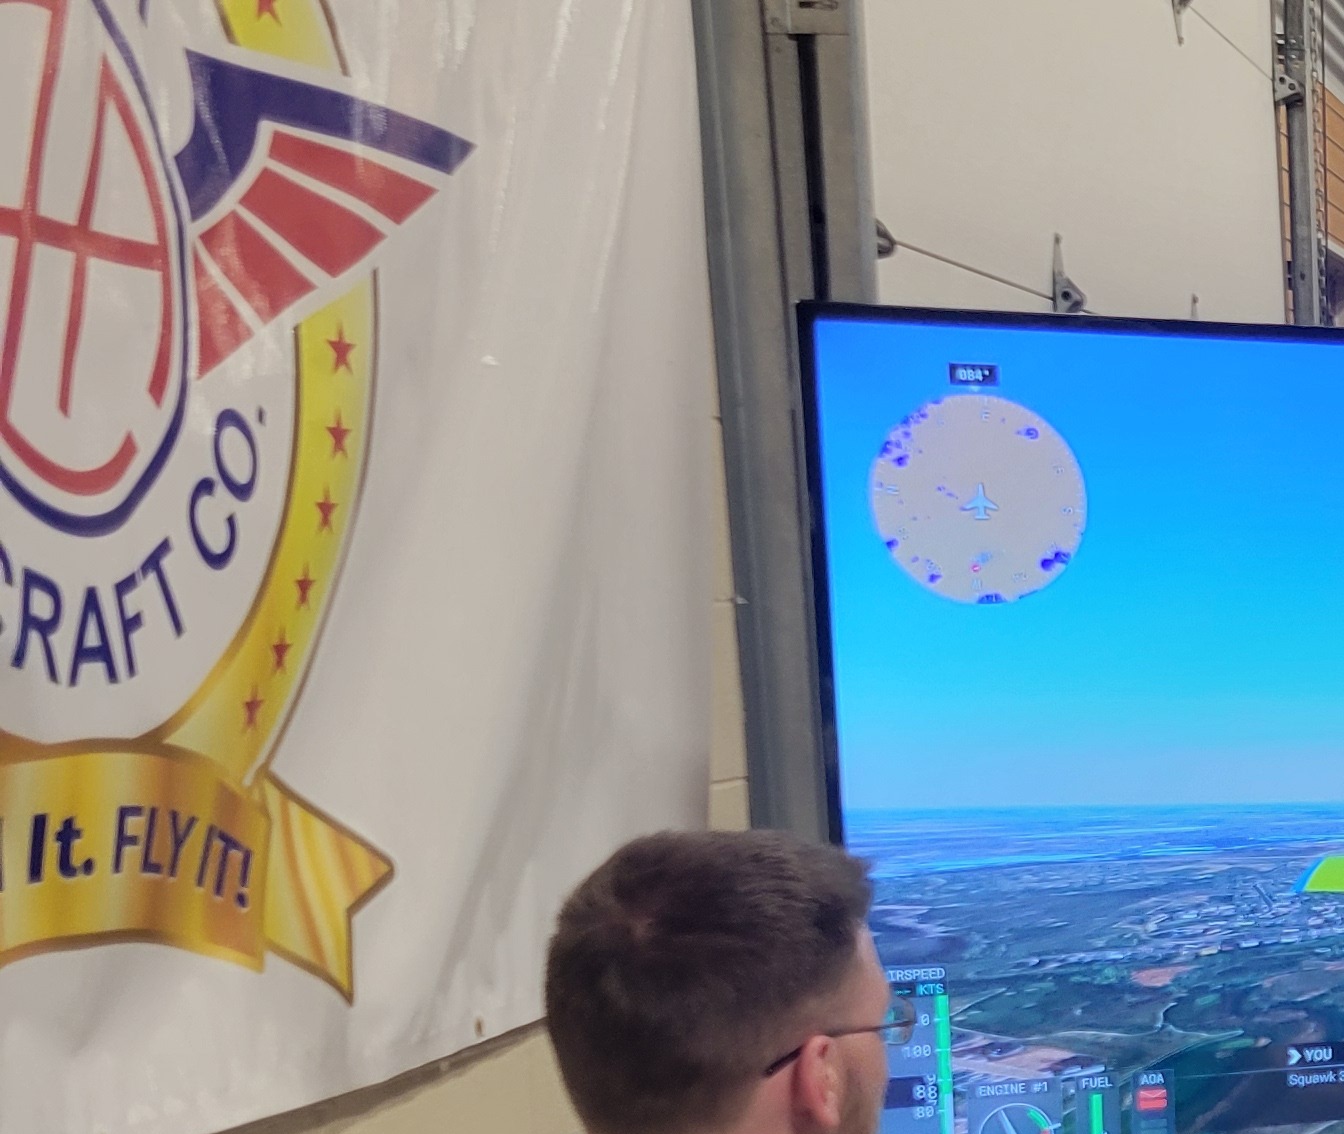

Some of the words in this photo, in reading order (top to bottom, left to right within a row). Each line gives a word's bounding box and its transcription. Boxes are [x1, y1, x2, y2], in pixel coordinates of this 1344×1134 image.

[187, 405, 267, 571] CO.
[28, 813, 96, 884] It.
[112, 804, 199, 879] FLY
[195, 822, 253, 909] IT!
[888, 967, 946, 981] IRSPEED
[919, 983, 944, 995] KTS
[1303, 1048, 1333, 1063] YOU
[1082, 1076, 1113, 1089] FUEL
[1140, 1073, 1166, 1085] AOA
[1288, 1071, 1337, 1088] Squawk
[978, 1084, 1027, 1097] ENGINE
[1033, 1081, 1049, 1093] #1
[915, 1108, 935, 1120] 80
